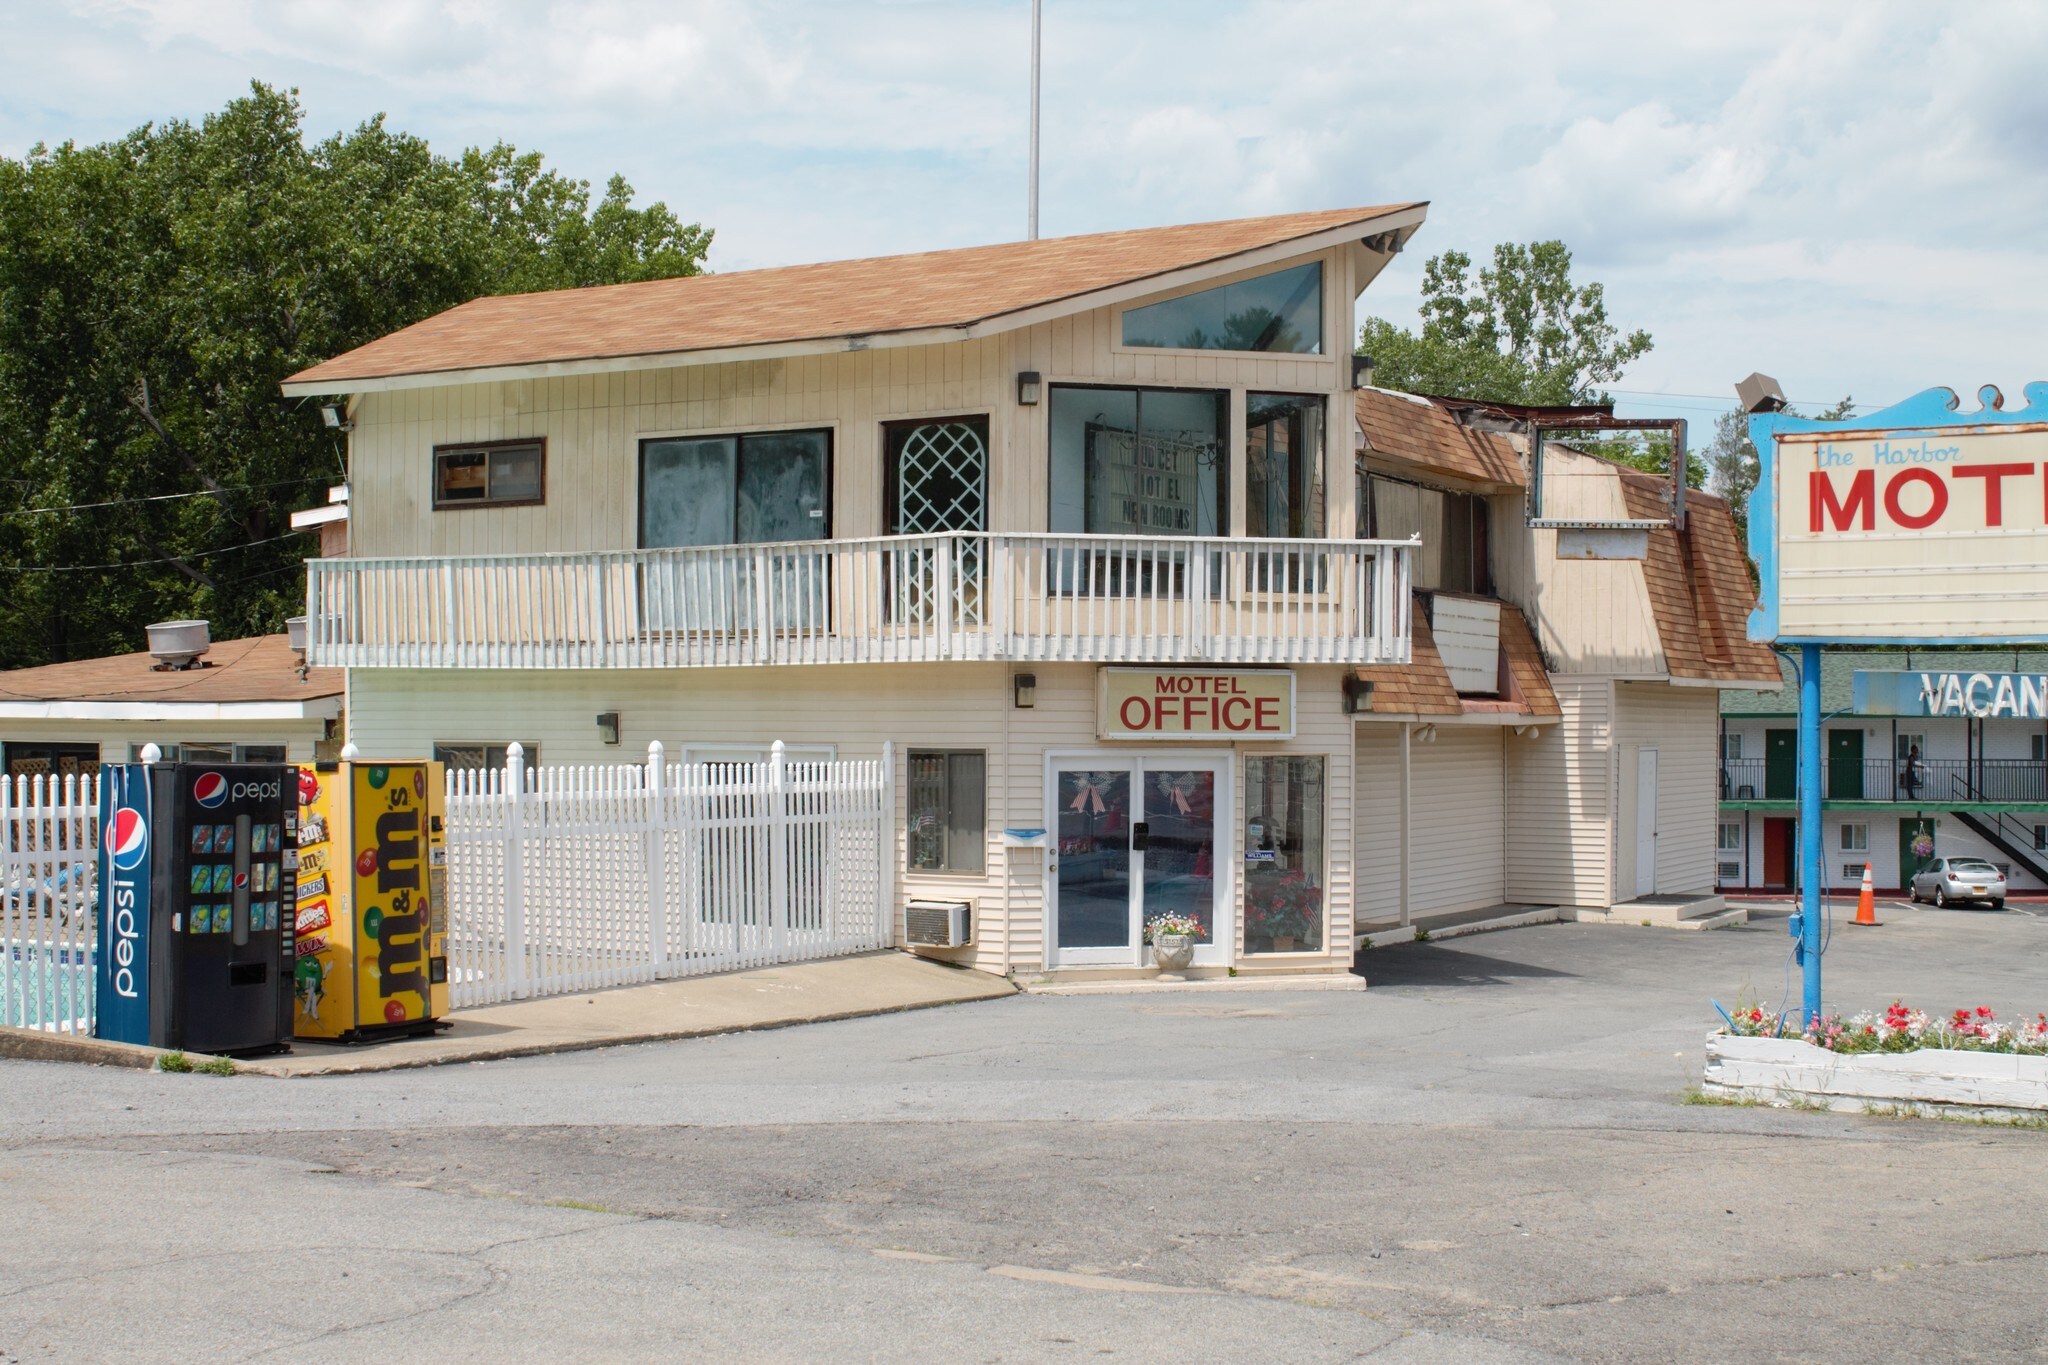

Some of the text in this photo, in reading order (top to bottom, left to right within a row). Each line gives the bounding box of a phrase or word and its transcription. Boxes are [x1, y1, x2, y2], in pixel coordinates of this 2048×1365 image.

[1817, 441, 1964, 468] the Harbor
[1809, 461, 2048, 533] MOT
[1155, 676, 1247, 694] MOTEL
[1919, 673, 2048, 718] VACAN
[1119, 696, 1281, 731] OFFICE
[232, 778, 281, 803] pepsi
[115, 880, 139, 998] pepsi
